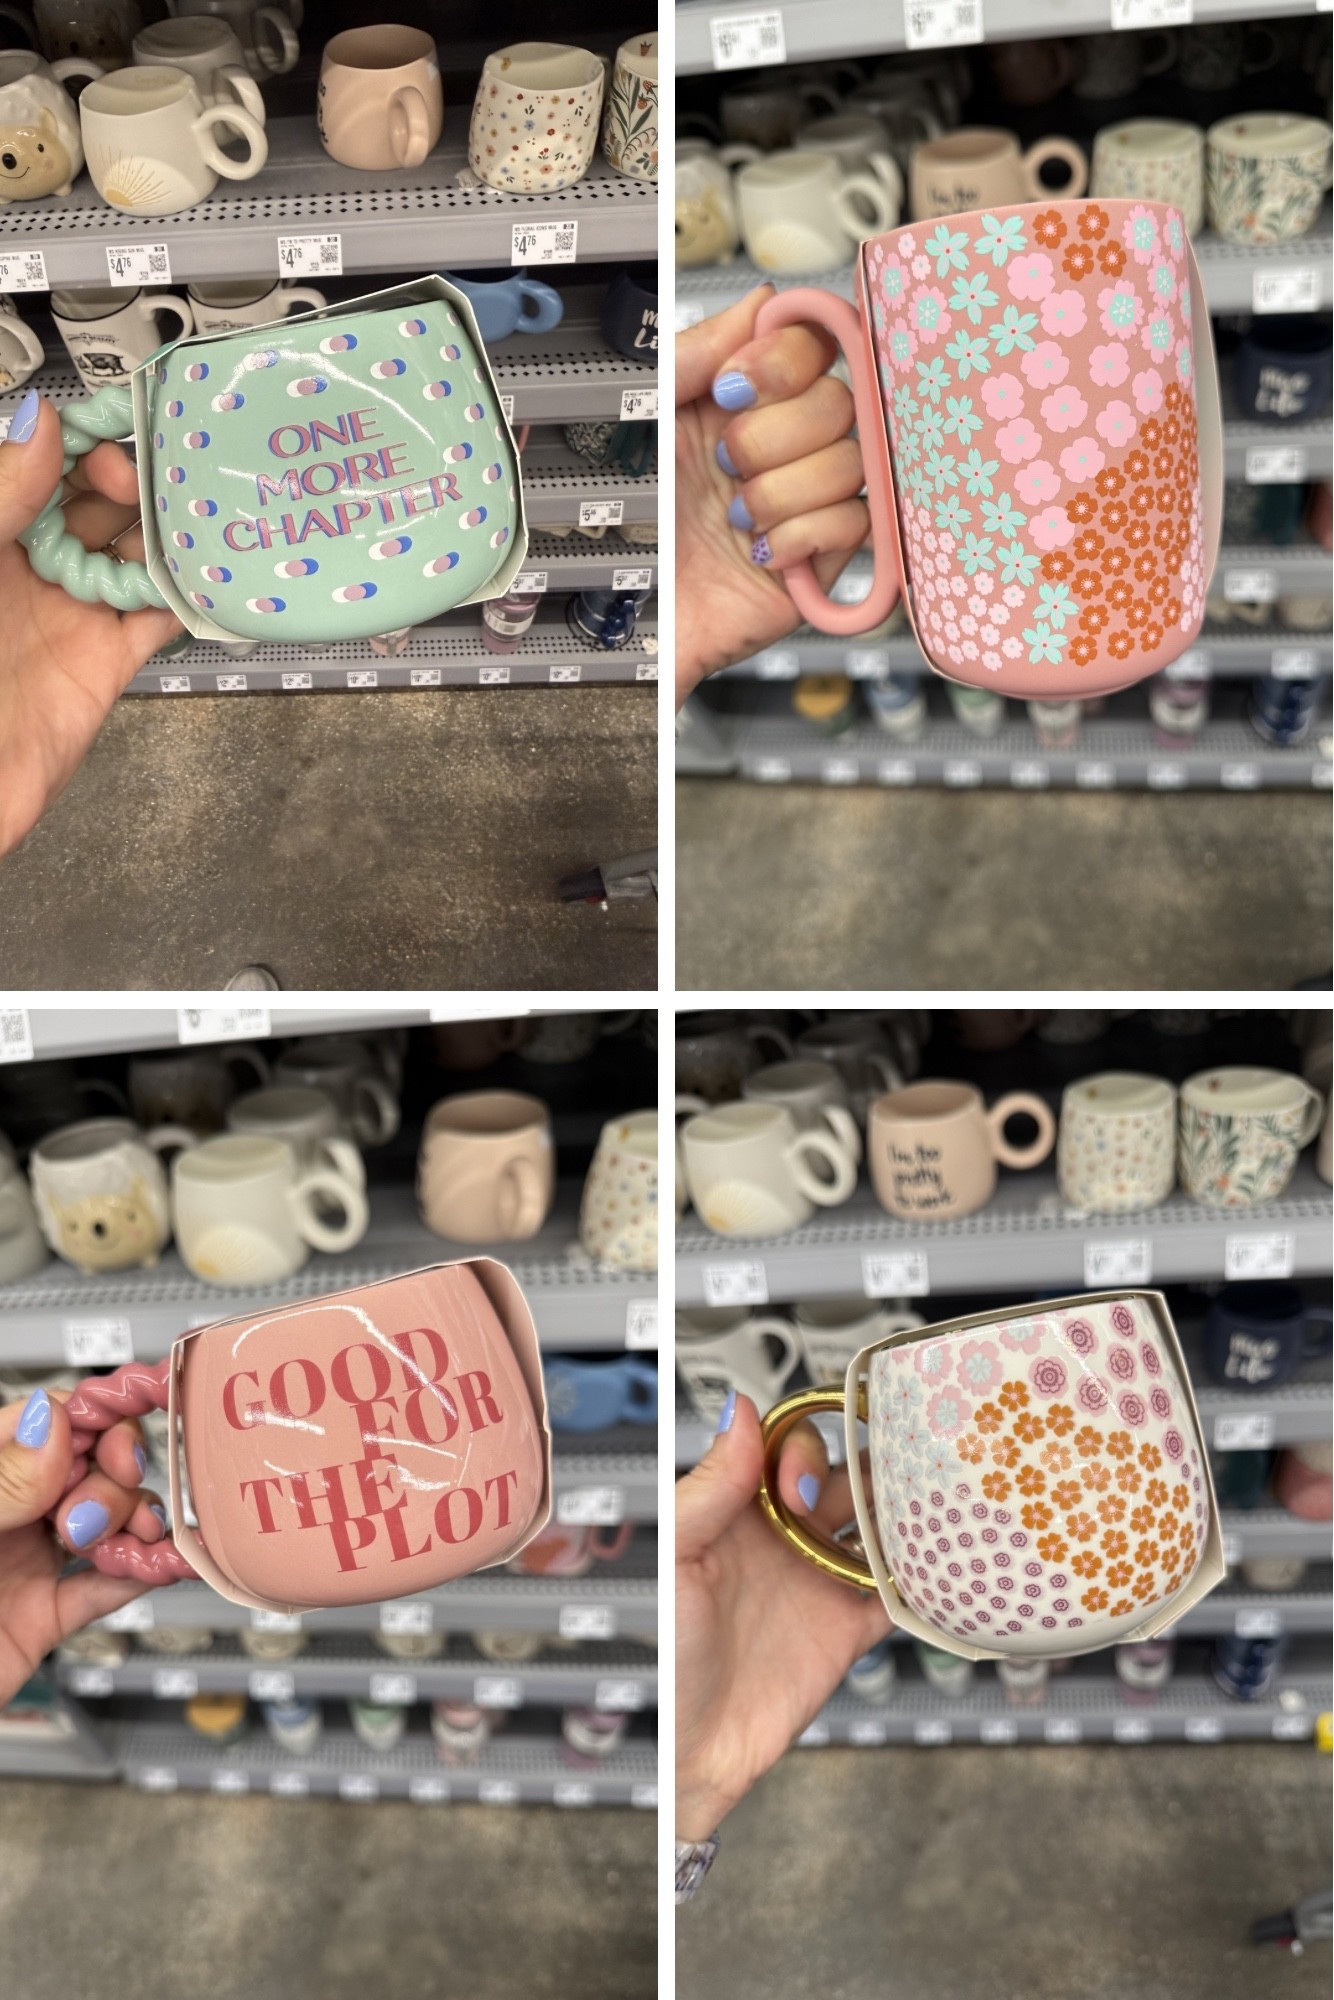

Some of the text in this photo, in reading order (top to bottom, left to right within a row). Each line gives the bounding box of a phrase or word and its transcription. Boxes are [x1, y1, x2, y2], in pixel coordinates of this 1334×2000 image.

[268, 406, 385, 459] ONE
[222, 472, 463, 552] CHAPTER
[255, 442, 415, 507] MORE
[222, 1327, 450, 1431] GOOD
[350, 1370, 504, 1461] FOR
[239, 1453, 409, 1535] THE
[323, 1469, 518, 1573] PLOT
